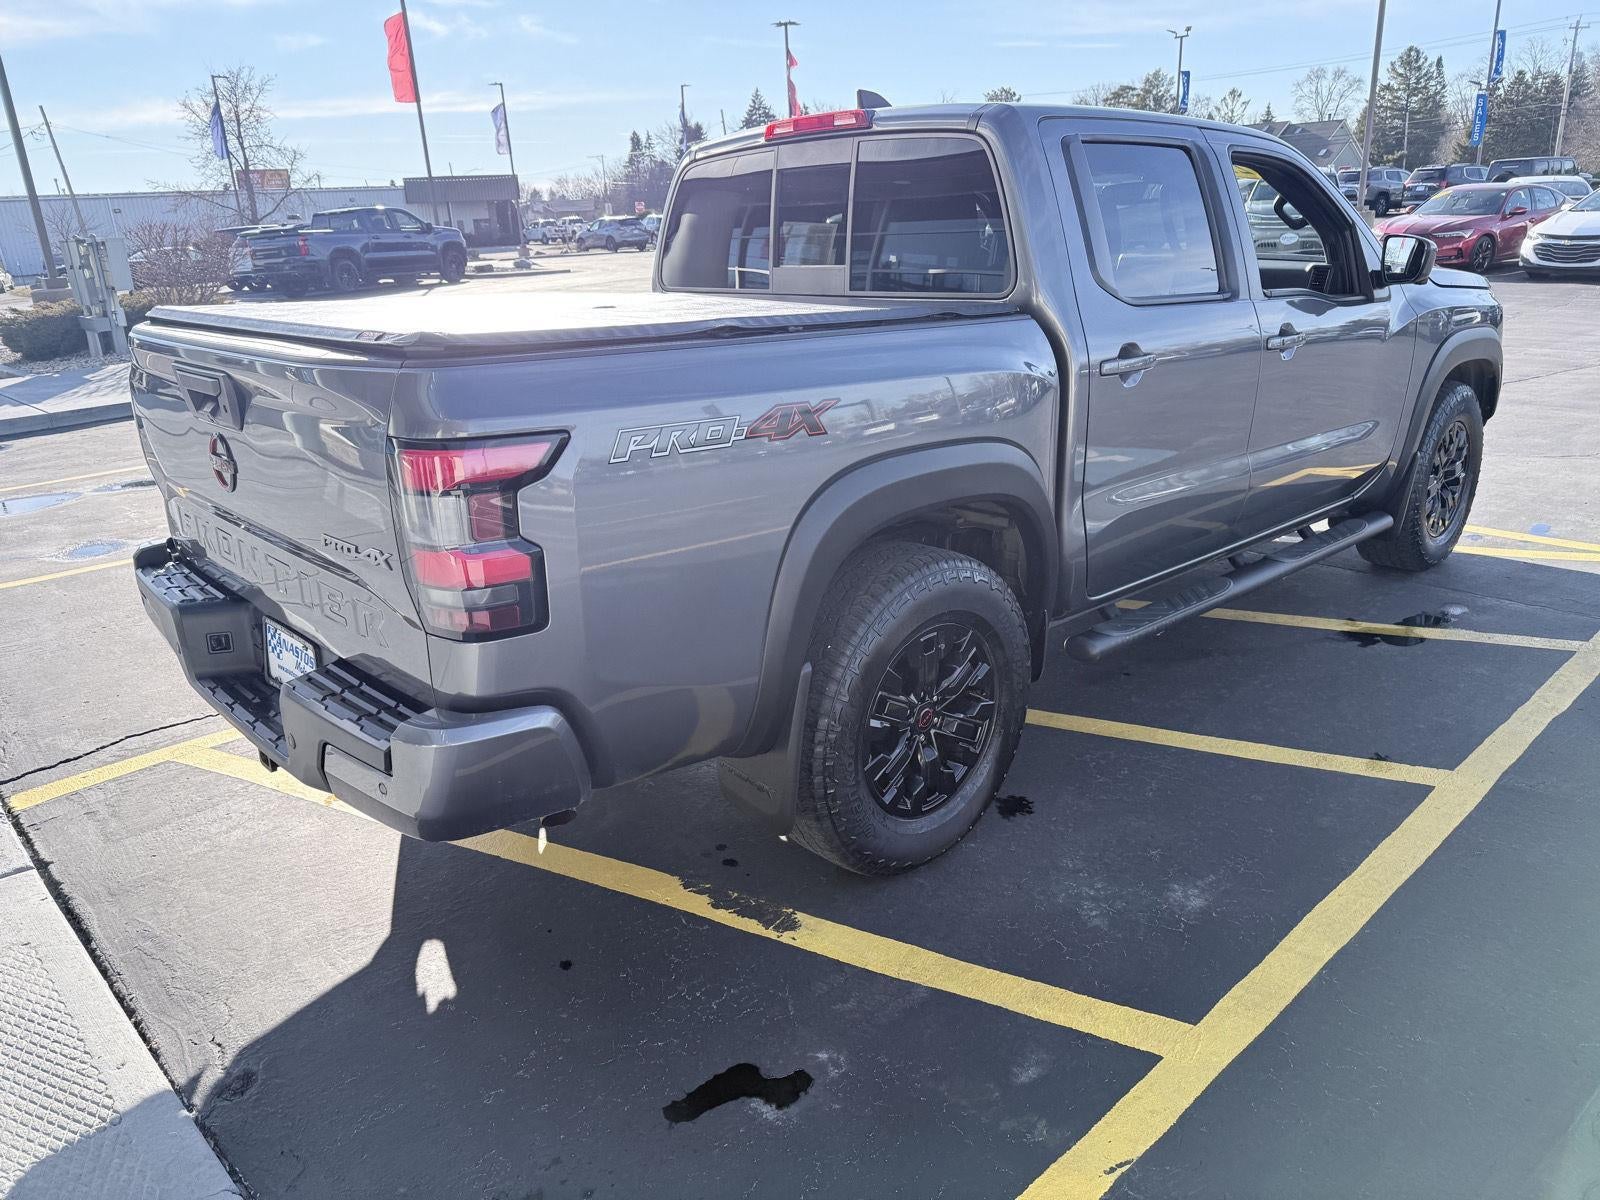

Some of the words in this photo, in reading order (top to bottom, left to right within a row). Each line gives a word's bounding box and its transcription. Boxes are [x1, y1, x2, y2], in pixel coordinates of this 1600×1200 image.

[1473, 98, 1484, 141] SALES
[176, 503, 390, 648] FRONTIER
[275, 632, 315, 670] ANASTOS
